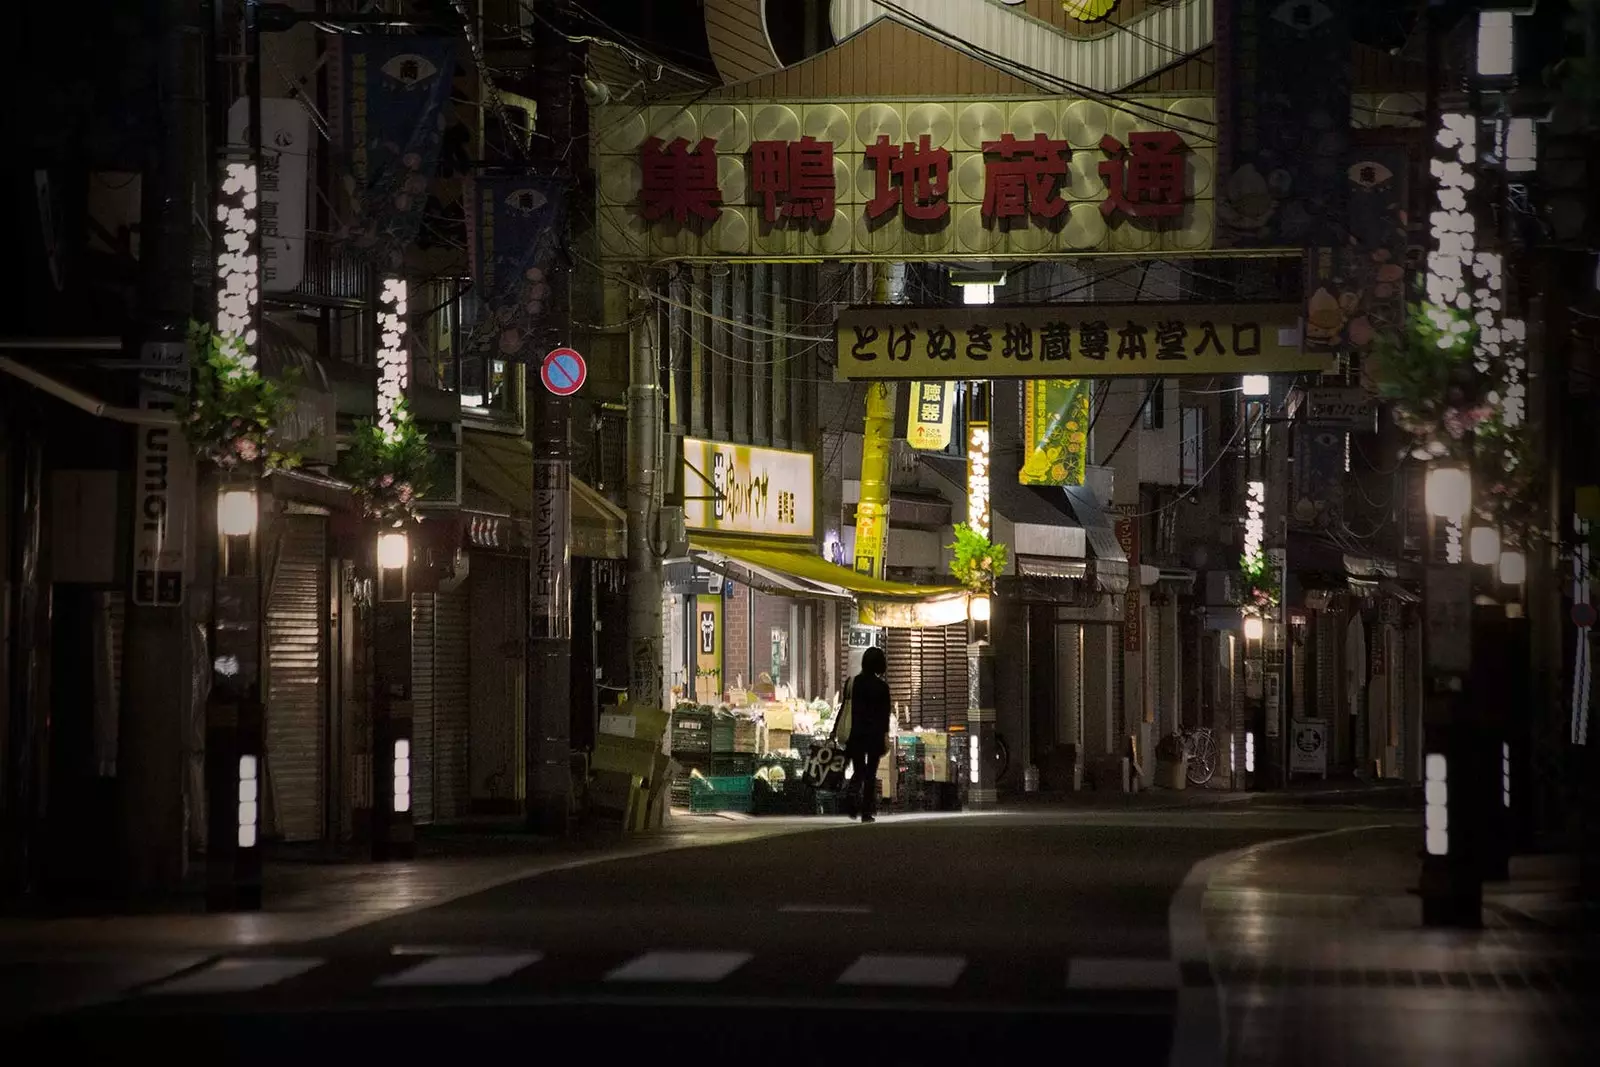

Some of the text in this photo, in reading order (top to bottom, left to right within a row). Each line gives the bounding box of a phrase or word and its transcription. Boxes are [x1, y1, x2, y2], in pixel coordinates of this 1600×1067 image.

[851, 320, 1261, 361] とげぬき地蔵尊本堂入口
[803, 747, 845, 787] itoya
